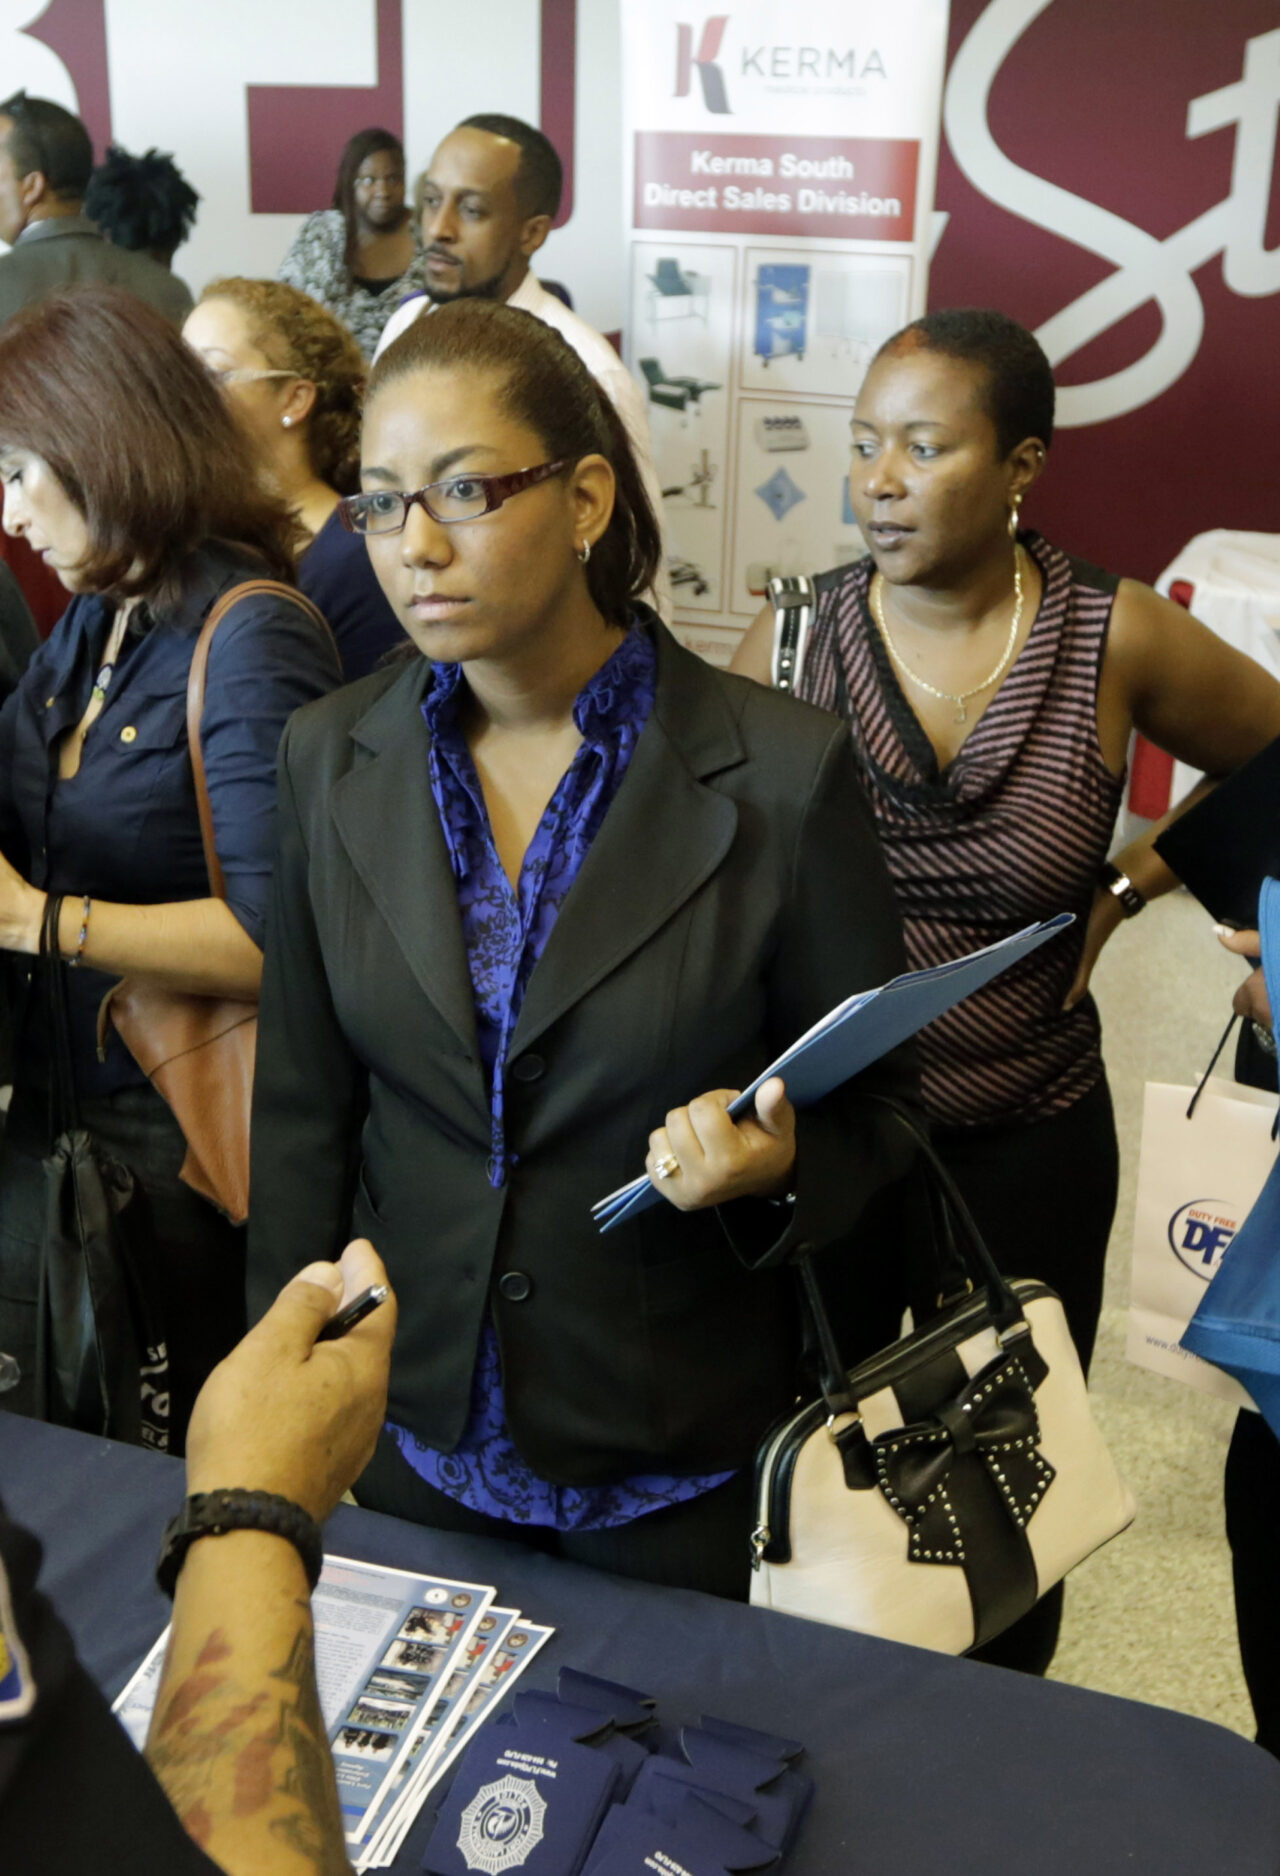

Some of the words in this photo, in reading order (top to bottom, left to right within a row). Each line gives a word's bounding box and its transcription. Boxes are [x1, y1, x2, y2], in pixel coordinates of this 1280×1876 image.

[741, 46, 887, 79] KERMA
[691, 150, 774, 176] Kerma
[779, 153, 855, 180] South
[644, 182, 718, 209] Direct
[723, 185, 792, 212] Sales
[797, 188, 902, 217] Division
[1188, 1208, 1213, 1222] DUTY
[1214, 1216, 1237, 1229] FREE
[1182, 1218, 1234, 1265] DF
